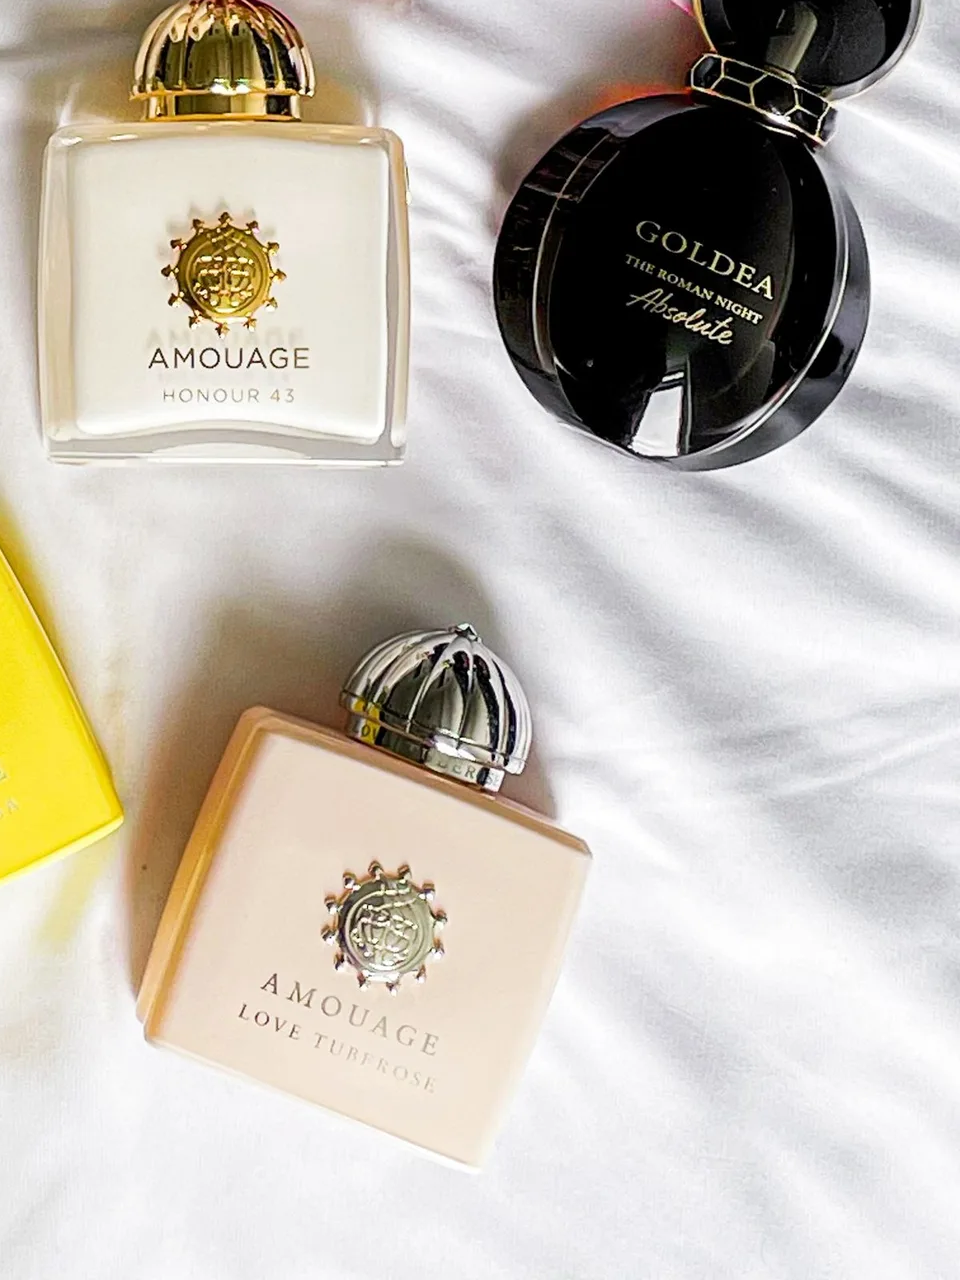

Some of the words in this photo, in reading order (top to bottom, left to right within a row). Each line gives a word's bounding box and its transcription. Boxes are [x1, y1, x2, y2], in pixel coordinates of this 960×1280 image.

[625, 254, 656, 275] THE
[656, 268, 715, 301] ROMAN
[714, 294, 764, 325] NIGHT
[635, 220, 774, 300] GOLDEA
[625, 287, 734, 346] Absolute
[148, 347, 310, 369] AMOUAGE
[162, 387, 260, 403] HONOUR
[270, 387, 295, 403] 43
[238, 1003, 303, 1041] LOVE
[260, 972, 440, 1057] AMOUAGE
